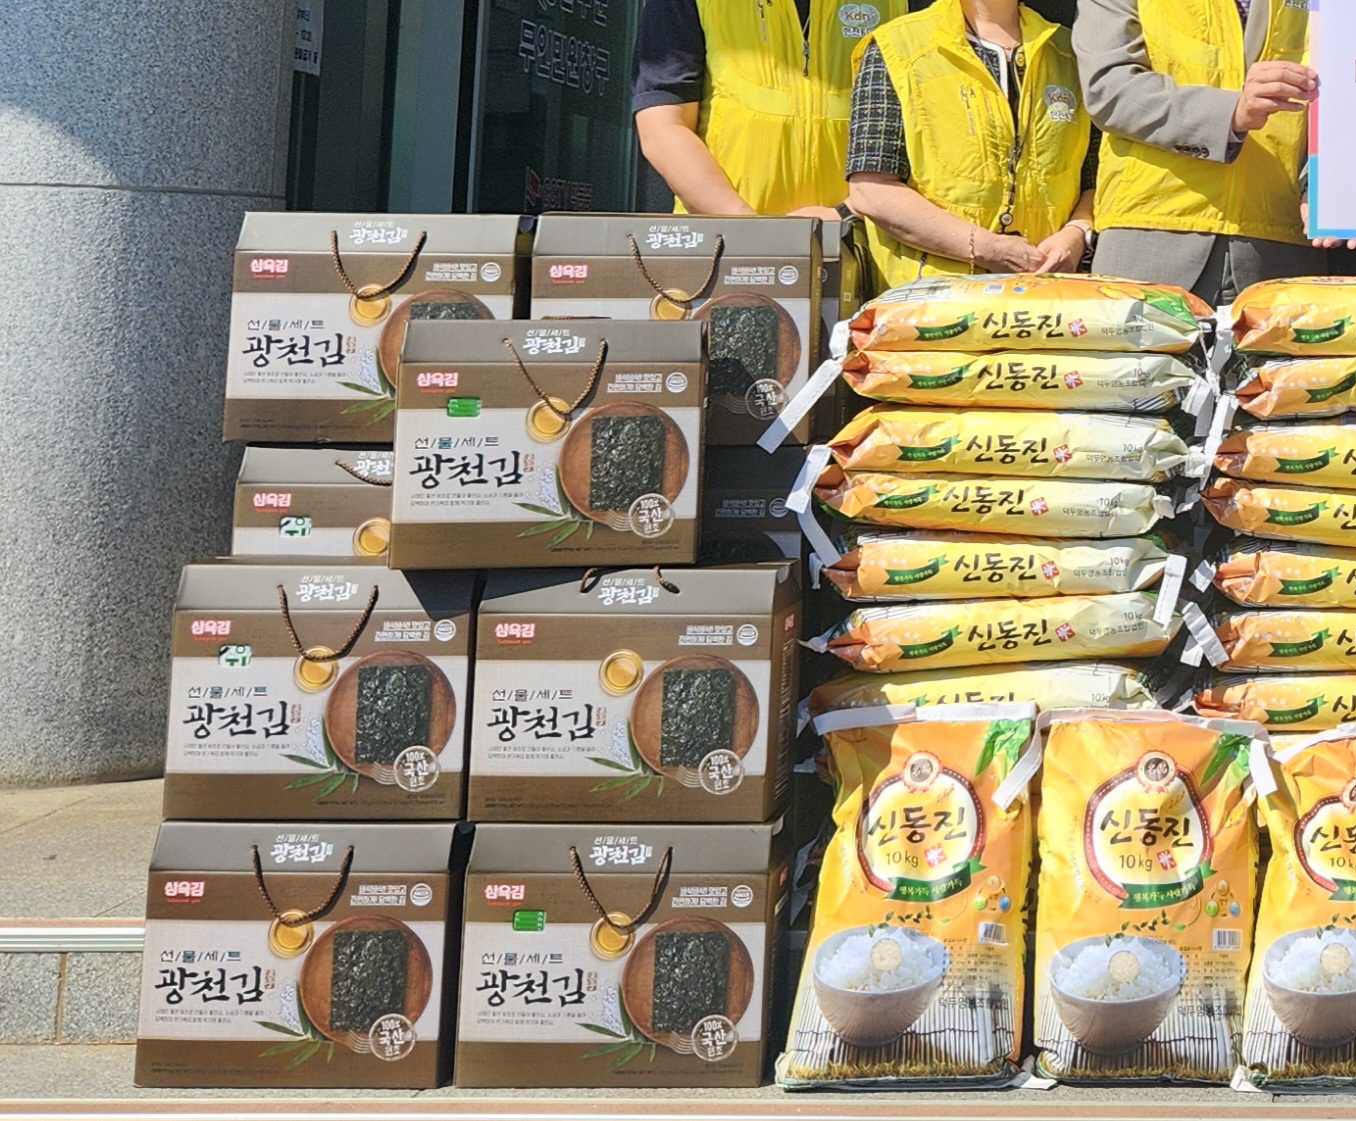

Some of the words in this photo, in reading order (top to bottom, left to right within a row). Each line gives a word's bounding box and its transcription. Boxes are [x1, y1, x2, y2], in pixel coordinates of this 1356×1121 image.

[250, 258, 289, 273] 삼육김
[550, 264, 588, 278] 삼육김
[247, 319, 324, 330] 선/물/세/트
[983, 311, 1065, 339] 신동진
[242, 334, 346, 368] 광천김
[417, 372, 458, 387] 삼육김
[978, 361, 1058, 391] 신동진
[752, 392, 778, 406] 국산
[414, 437, 499, 450] 선/물/세/트
[966, 434, 1049, 464] 신동진
[409, 450, 522, 489] 광천김
[253, 492, 292, 507] 삼육김
[943, 486, 1025, 516] 신동진
[638, 510, 664, 524] 국산
[954, 553, 1037, 582] 신동진
[191, 620, 231, 636] 삼육김
[495, 622, 536, 638] 삼육김
[968, 620, 1052, 652] 신동진
[187, 687, 267, 700] 선/물/세/트
[491, 689, 574, 702] 선/물/세/트
[182, 702, 290, 742] 광천김
[487, 704, 596, 743] 광천김
[400, 762, 429, 777] 국산
[706, 765, 735, 781] 국산
[866, 806, 966, 847] 신동진
[1100, 808, 1194, 848] 신동진
[164, 881, 204, 898] 삼육김
[484, 884, 526, 900] 삼육김
[160, 950, 241, 963] 선/물/세/트
[481, 952, 563, 964] 선/물/세/트
[154, 965, 265, 1004] 광천김
[475, 969, 585, 1006] 광천김
[378, 1030, 406, 1045] 국산
[700, 1031, 727, 1046] 국산
